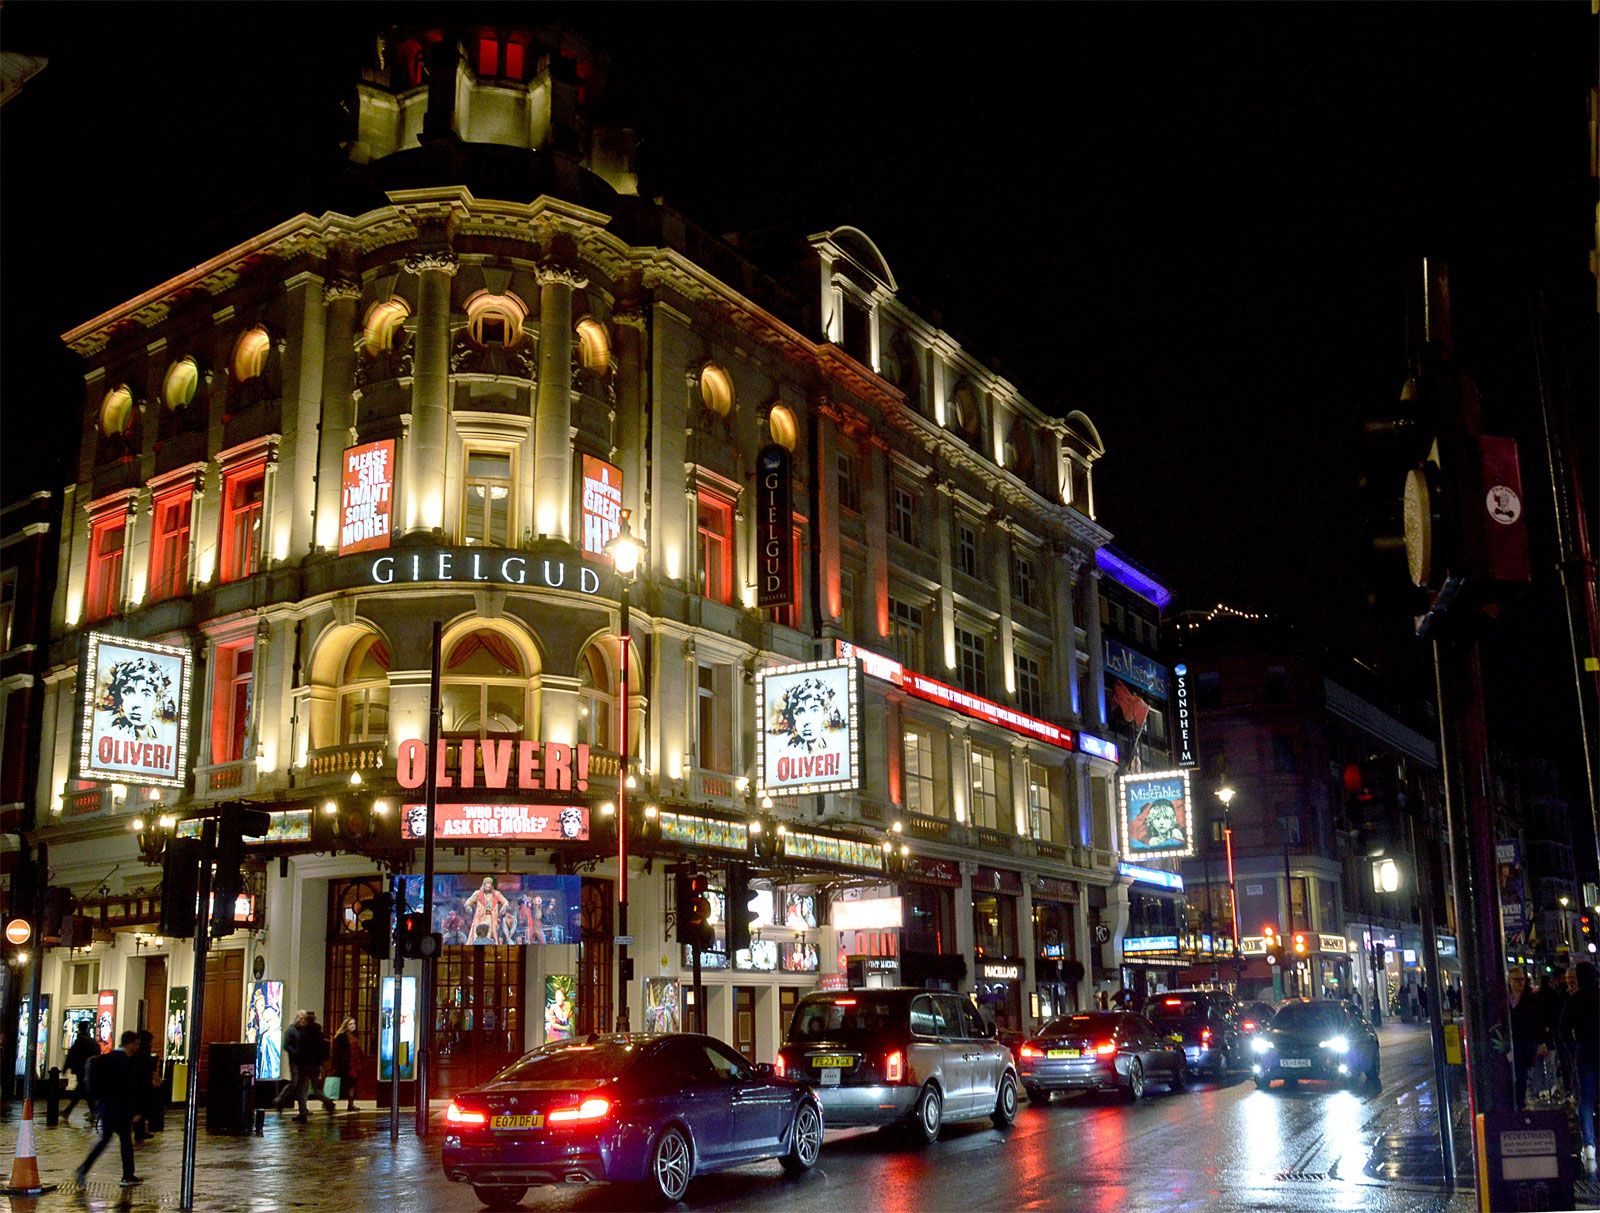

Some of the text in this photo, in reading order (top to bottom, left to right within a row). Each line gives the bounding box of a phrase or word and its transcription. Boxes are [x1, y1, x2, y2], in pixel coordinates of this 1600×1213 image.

[348, 449, 388, 473] PLEASE
[602, 467, 609, 485] A
[343, 483, 391, 508] I WANT
[583, 490, 621, 522] GREAT
[345, 502, 378, 525] SOME
[342, 513, 389, 547] MORE!
[765, 473, 781, 592] GIELGUD
[371, 553, 600, 594] GIELGUD
[1177, 677, 1192, 760] SONDHEIM
[98, 736, 173, 770] OLIVER!
[396, 738, 590, 792] OLIVER!
[777, 753, 841, 781] OLIVER!
[443, 818, 472, 835] ASK
[473, 817, 500, 835] FOR
[985, 965, 1018, 979] MACELLAIO
[519, 1115, 539, 1127] DFU
